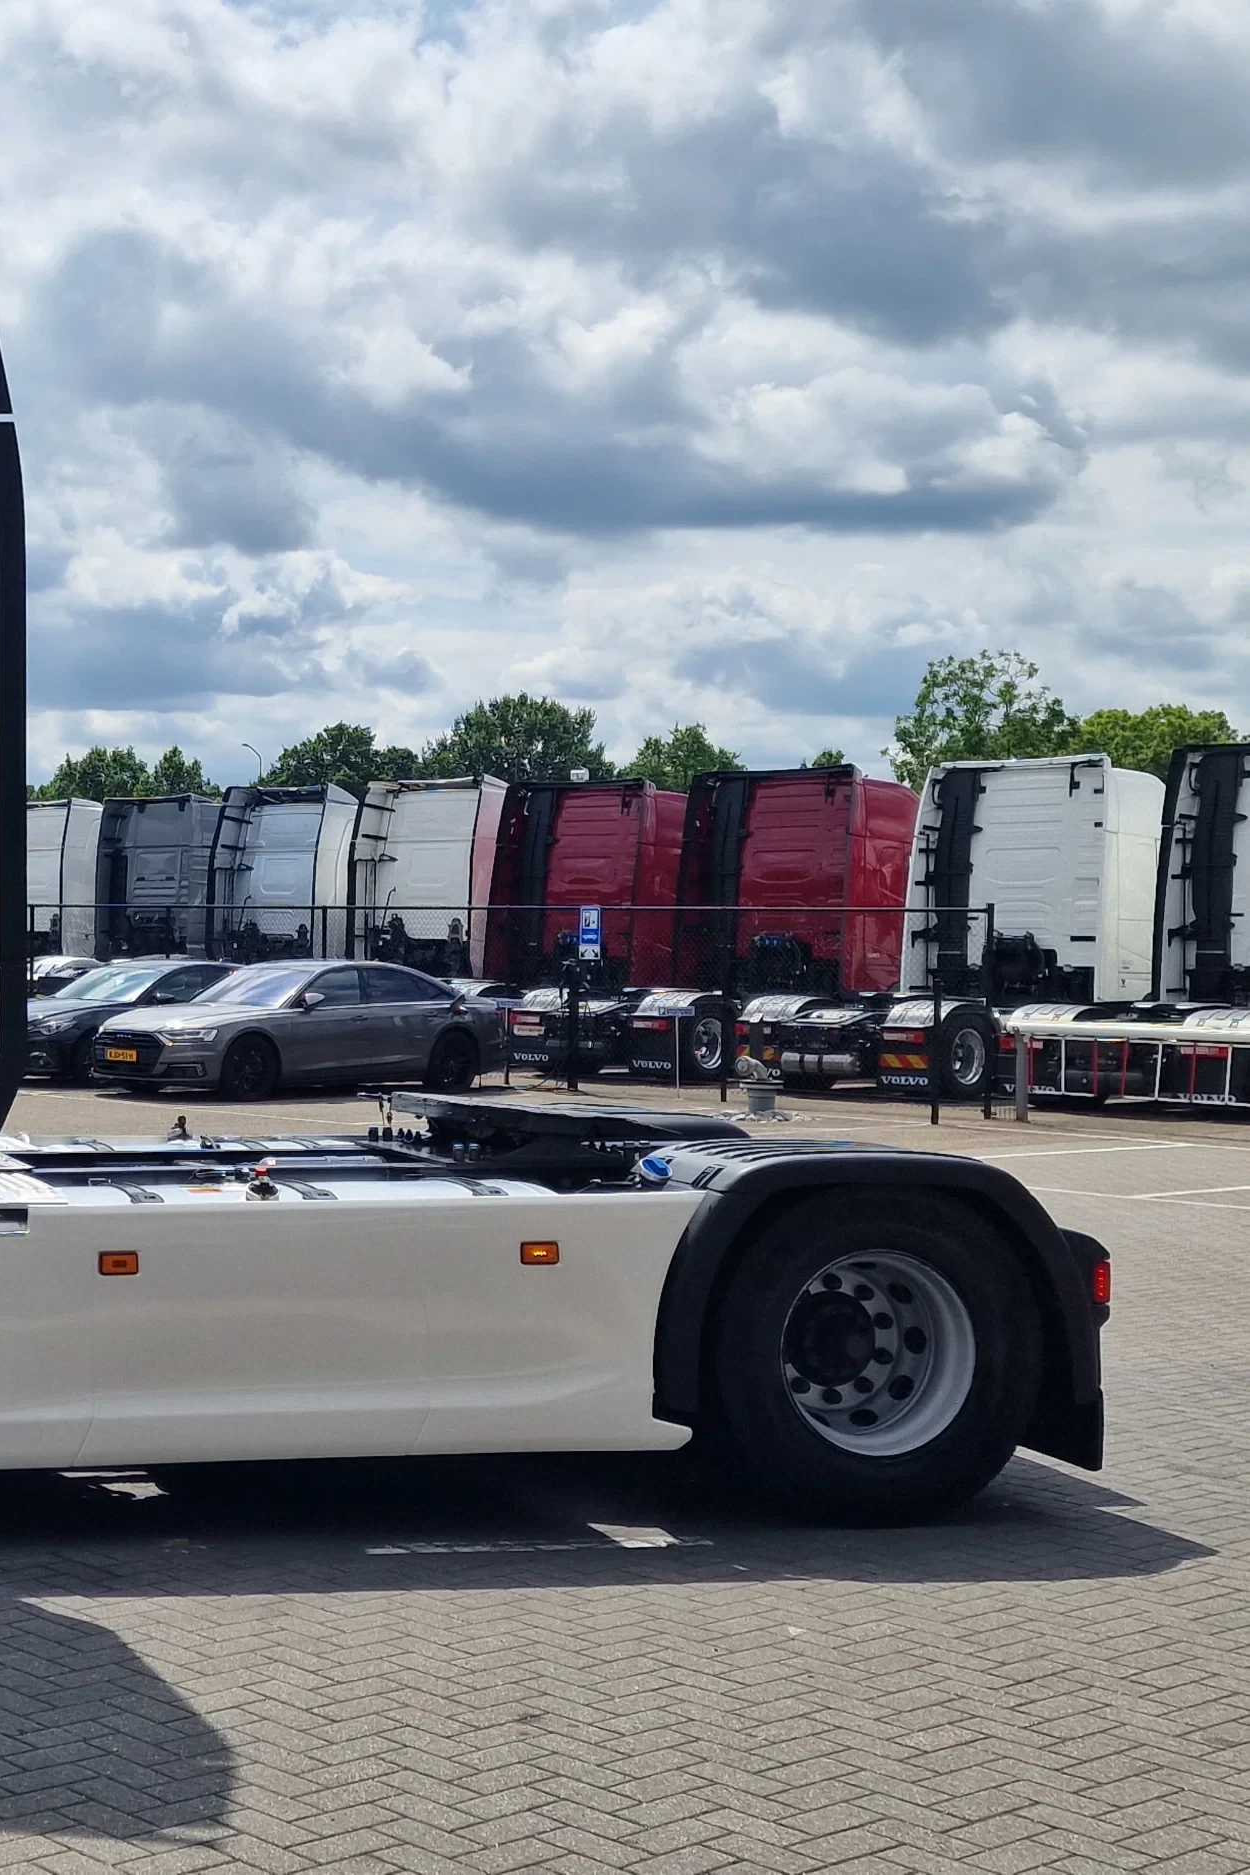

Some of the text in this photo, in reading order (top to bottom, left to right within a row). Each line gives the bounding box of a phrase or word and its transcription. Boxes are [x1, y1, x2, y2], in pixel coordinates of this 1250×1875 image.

[513, 1052, 549, 1062] VOLVO
[632, 1059, 672, 1070] VOLVO
[880, 1075, 929, 1086] VOLVO
